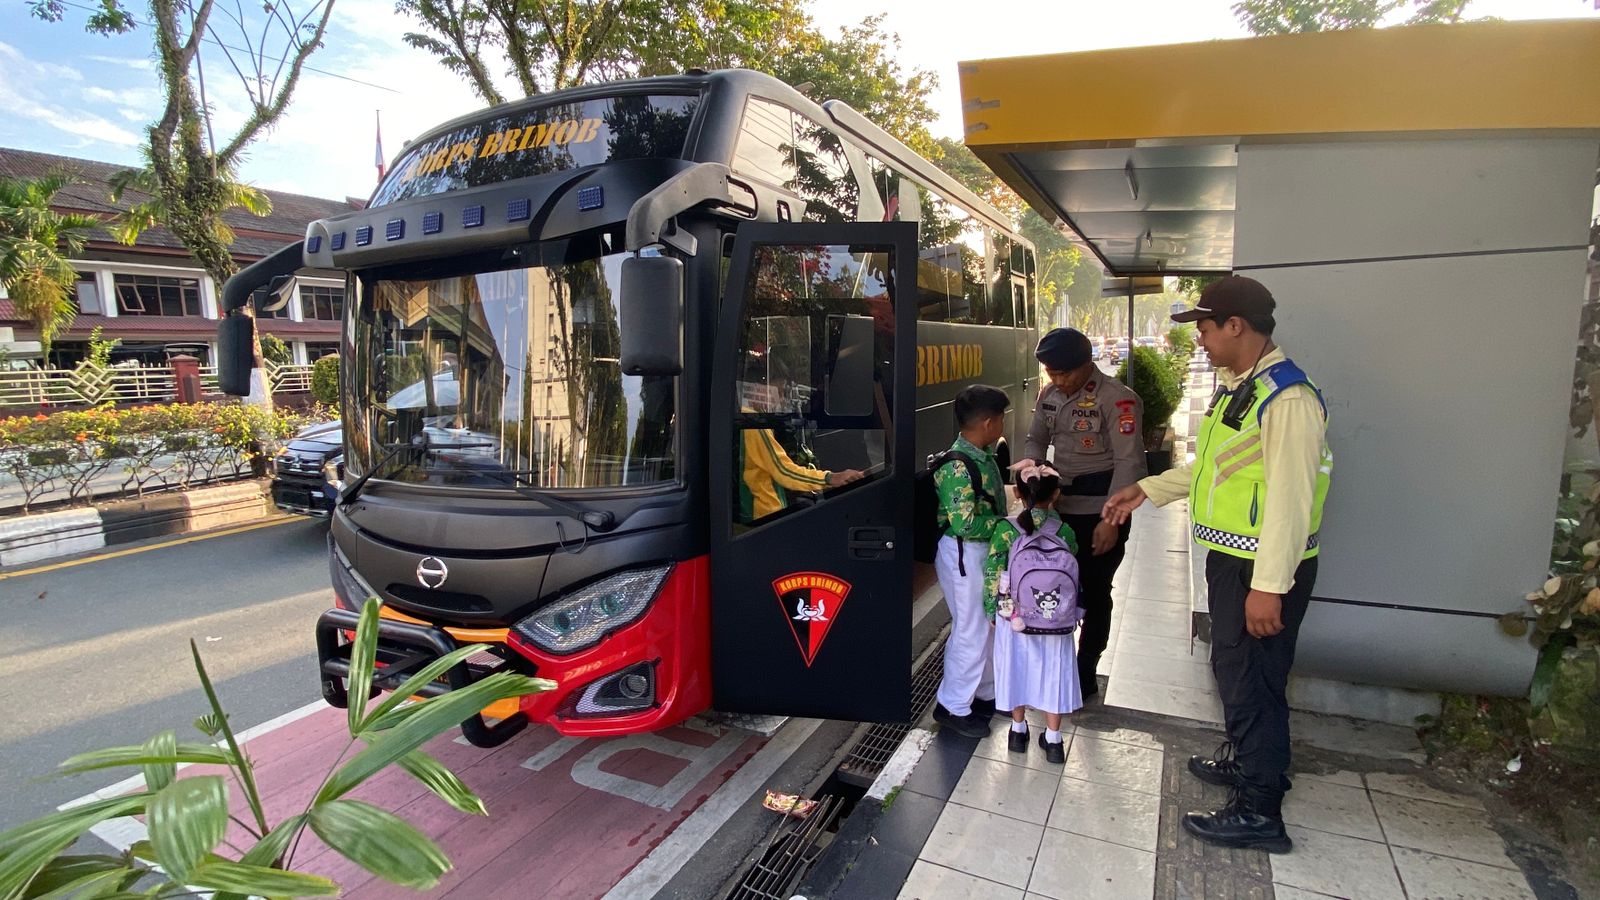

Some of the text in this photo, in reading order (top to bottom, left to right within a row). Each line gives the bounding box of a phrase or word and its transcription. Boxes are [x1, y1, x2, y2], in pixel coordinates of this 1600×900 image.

[479, 118, 602, 158] BRIMOB
[916, 344, 983, 387] BRIMOB
[1071, 409, 1099, 417] POLRI
[780, 577, 844, 593] KORPS BRIMOB
